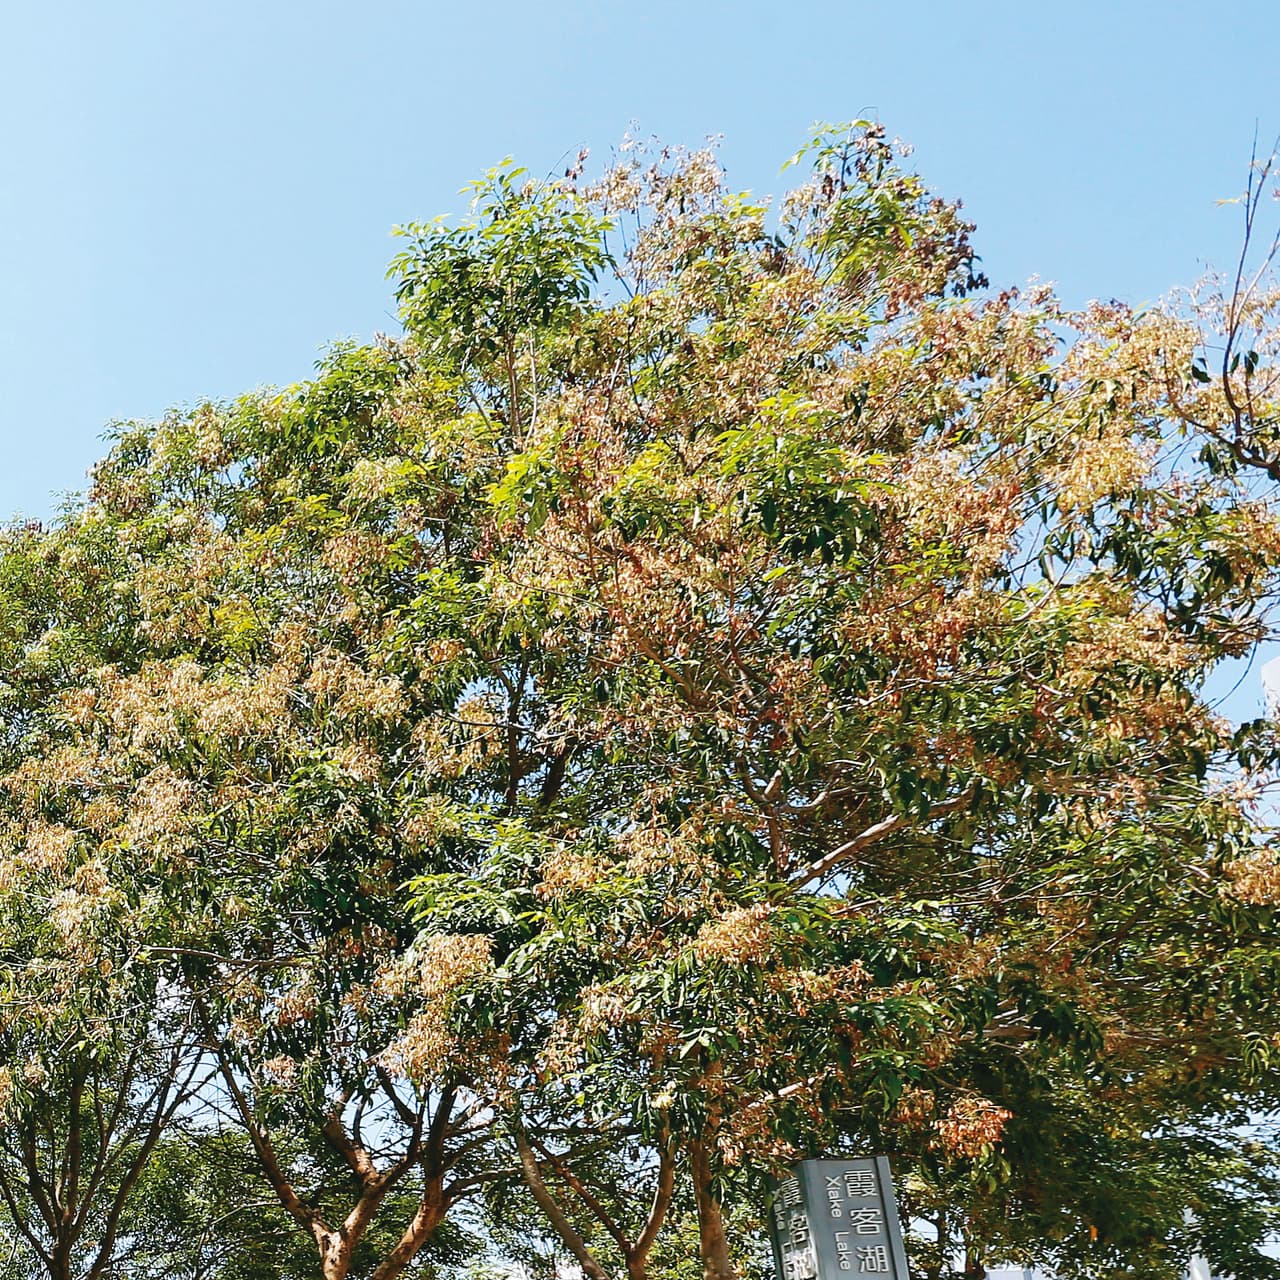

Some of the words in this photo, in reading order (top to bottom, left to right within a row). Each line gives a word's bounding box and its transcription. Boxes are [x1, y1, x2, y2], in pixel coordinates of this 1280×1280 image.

[824, 1175, 845, 1218] Xiake
[843, 1168, 890, 1274] 霞客湖
[834, 1230, 853, 1271] Lake
